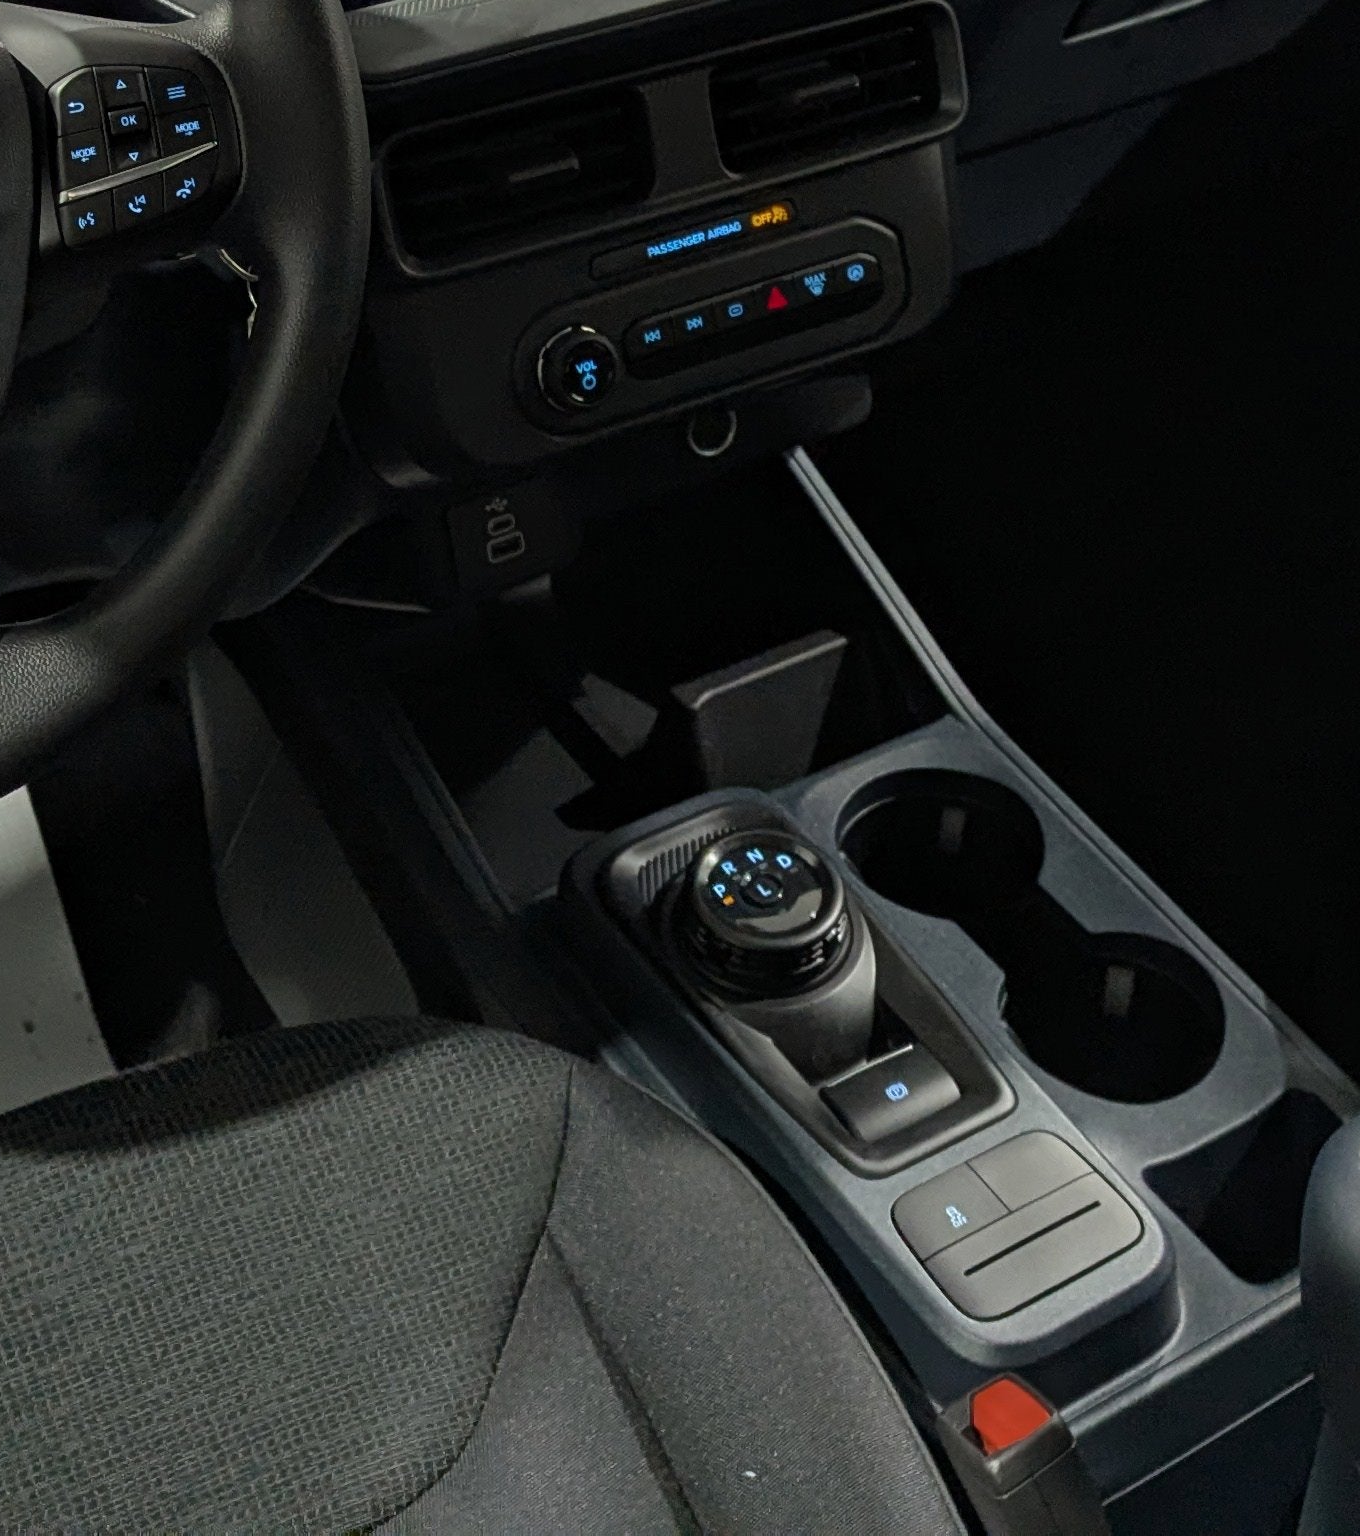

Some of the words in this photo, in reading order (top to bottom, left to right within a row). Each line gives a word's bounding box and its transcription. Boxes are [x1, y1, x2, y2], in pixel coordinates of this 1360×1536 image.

[120, 115, 138, 127] OK
[174, 120, 201, 133] MODE
[70, 146, 97, 159] MODE
[647, 232, 706, 258] PASSENGER
[707, 221, 742, 240] AIRBAG
[751, 212, 773, 227] OFF
[803, 271, 827, 287] MAX
[575, 360, 598, 375] VOL
[712, 884, 726, 898] P
[721, 861, 738, 876] R
[746, 848, 765, 864] N
[776, 854, 792, 869] D
